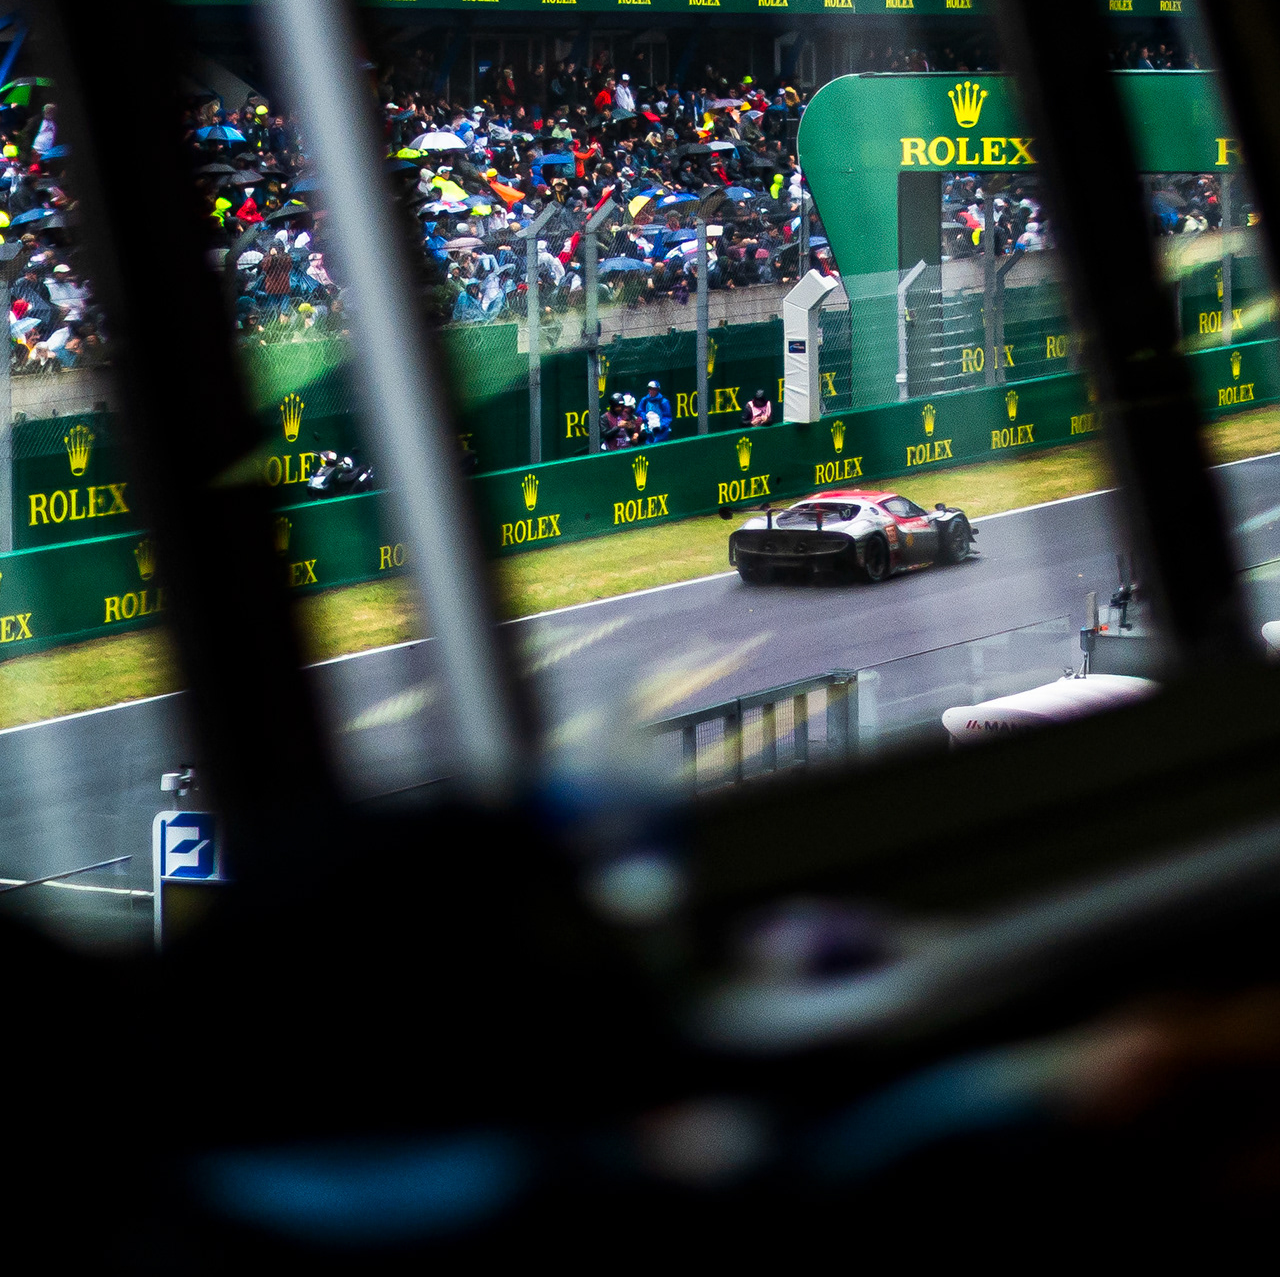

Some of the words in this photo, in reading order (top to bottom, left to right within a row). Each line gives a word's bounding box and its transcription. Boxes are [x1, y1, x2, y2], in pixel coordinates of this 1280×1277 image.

[900, 137, 1038, 166] ROLEX
[1218, 381, 1255, 408] ROLEX
[991, 423, 1035, 451] ROLEX
[814, 455, 863, 486] ROLEX
[29, 483, 131, 526] ROLEX
[717, 473, 770, 505] ROLEX
[613, 493, 669, 525] ROLEX
[501, 513, 561, 547] ROLEX
